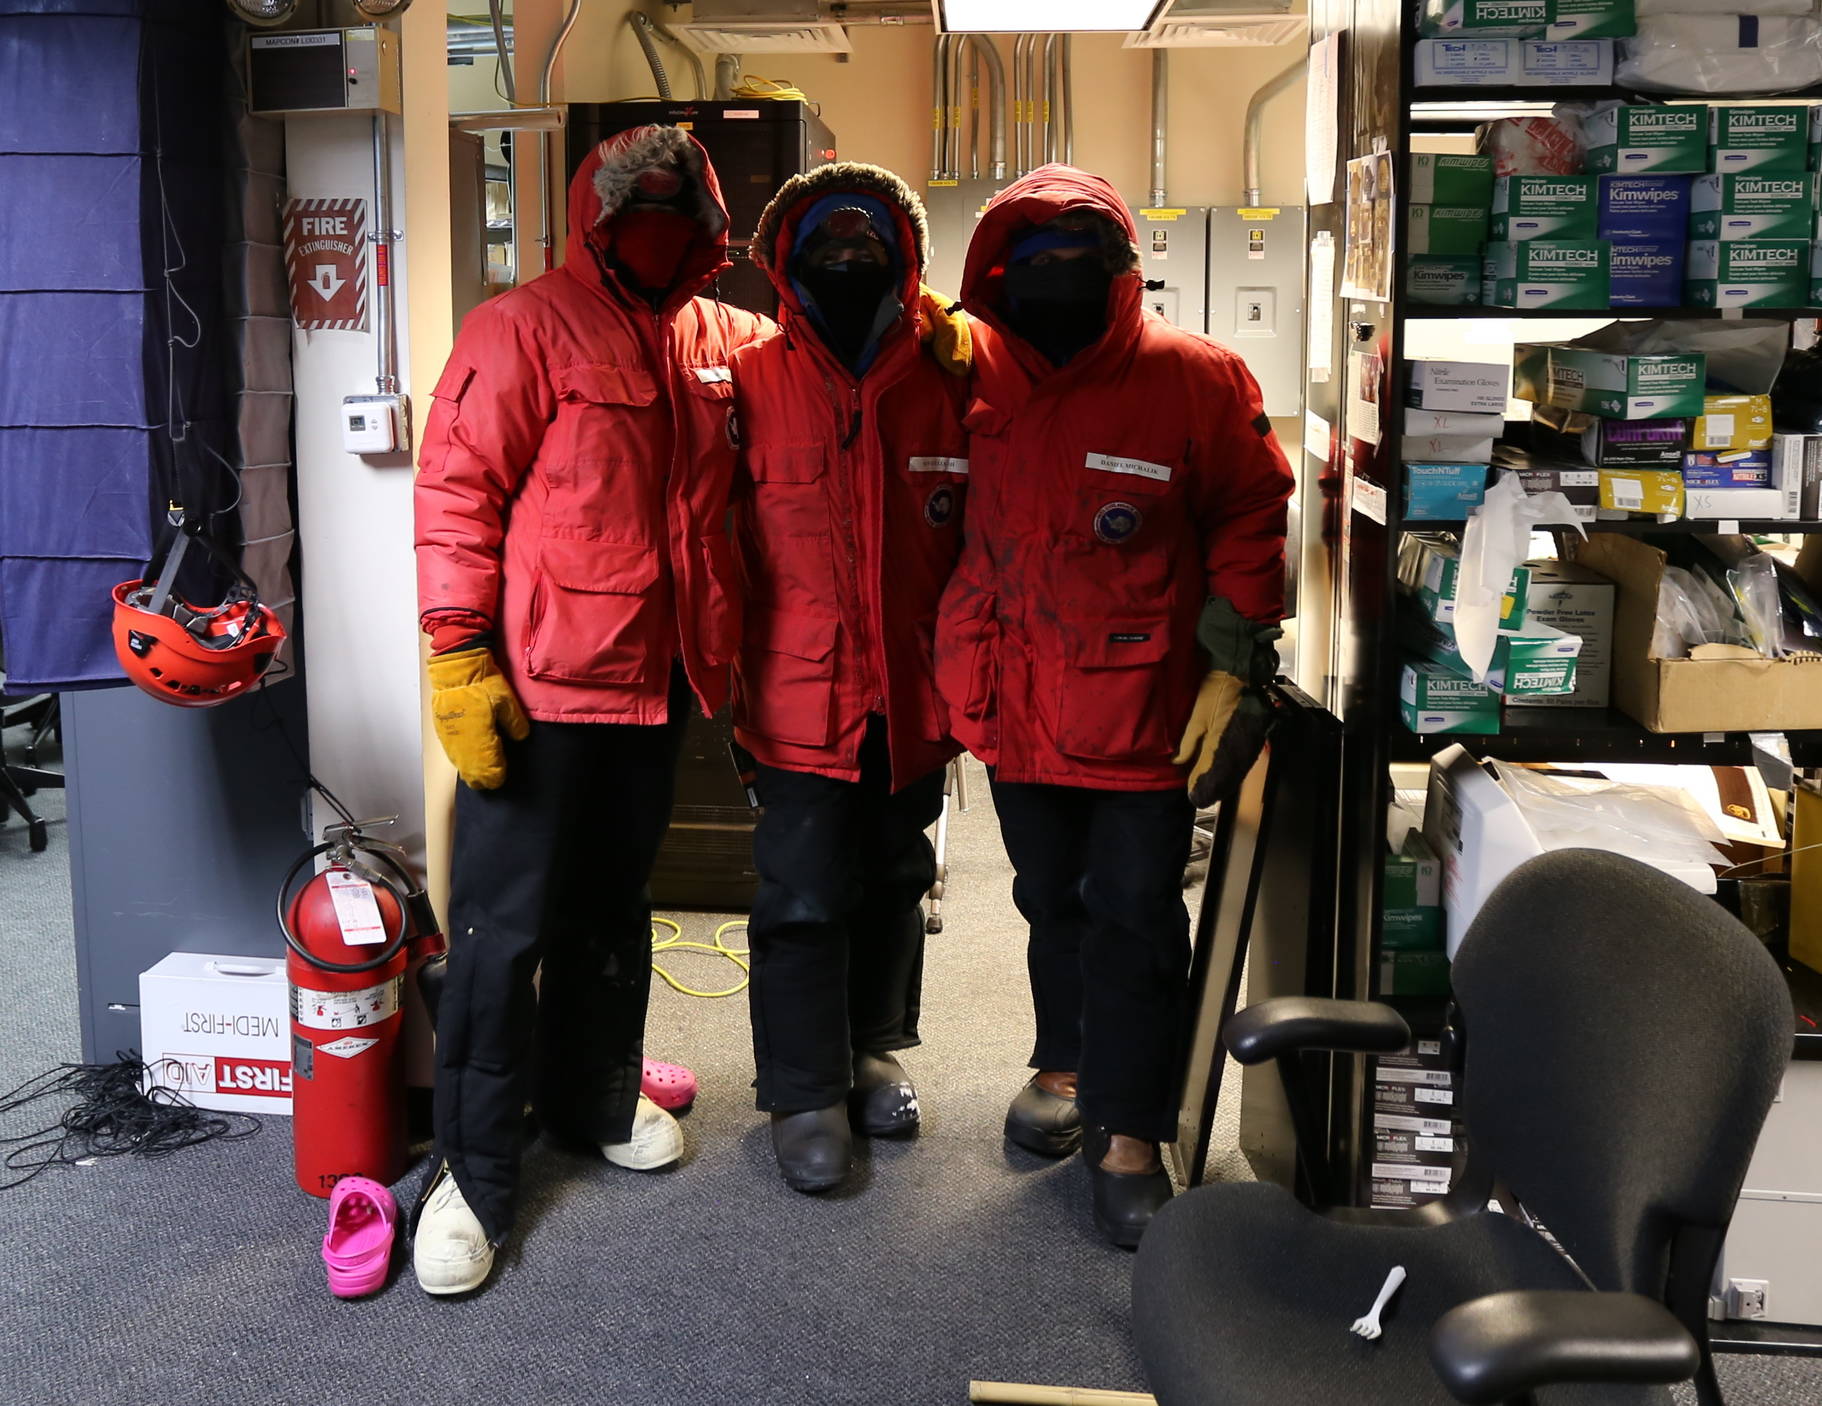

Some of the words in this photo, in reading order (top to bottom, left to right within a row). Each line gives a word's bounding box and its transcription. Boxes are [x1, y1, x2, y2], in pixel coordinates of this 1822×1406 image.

[1476, 7, 1546, 20] KIMTECH
[1629, 113, 1697, 126] KIMTECH
[1728, 114, 1797, 127] KIMTECH
[1520, 184, 1587, 196] KIMTECH
[1735, 181, 1803, 193] KIMTECH
[1609, 188, 1679, 203] Kimwipes
[302, 216, 348, 236] FIRE
[297, 239, 354, 257] EXTINGUISHER
[1528, 249, 1598, 261] KIMTECH
[1729, 249, 1798, 261] KIMTECH
[1413, 270, 1465, 283] Kimwipes
[1638, 363, 1697, 376] KIMTECH
[1477, 378, 1500, 388] Gloves
[1434, 416, 1449, 429] XL
[1694, 495, 1712, 511] XS
[1526, 608, 1554, 617] Powder
[1427, 679, 1489, 692] KIMTECH
[1513, 677, 1565, 689] KIMTECH
[184, 1011, 279, 1038] MEDI-FIRST
[166, 1061, 213, 1087] AID
[218, 1063, 291, 1093] FIRST
[319, 1171, 363, 1189] 13
